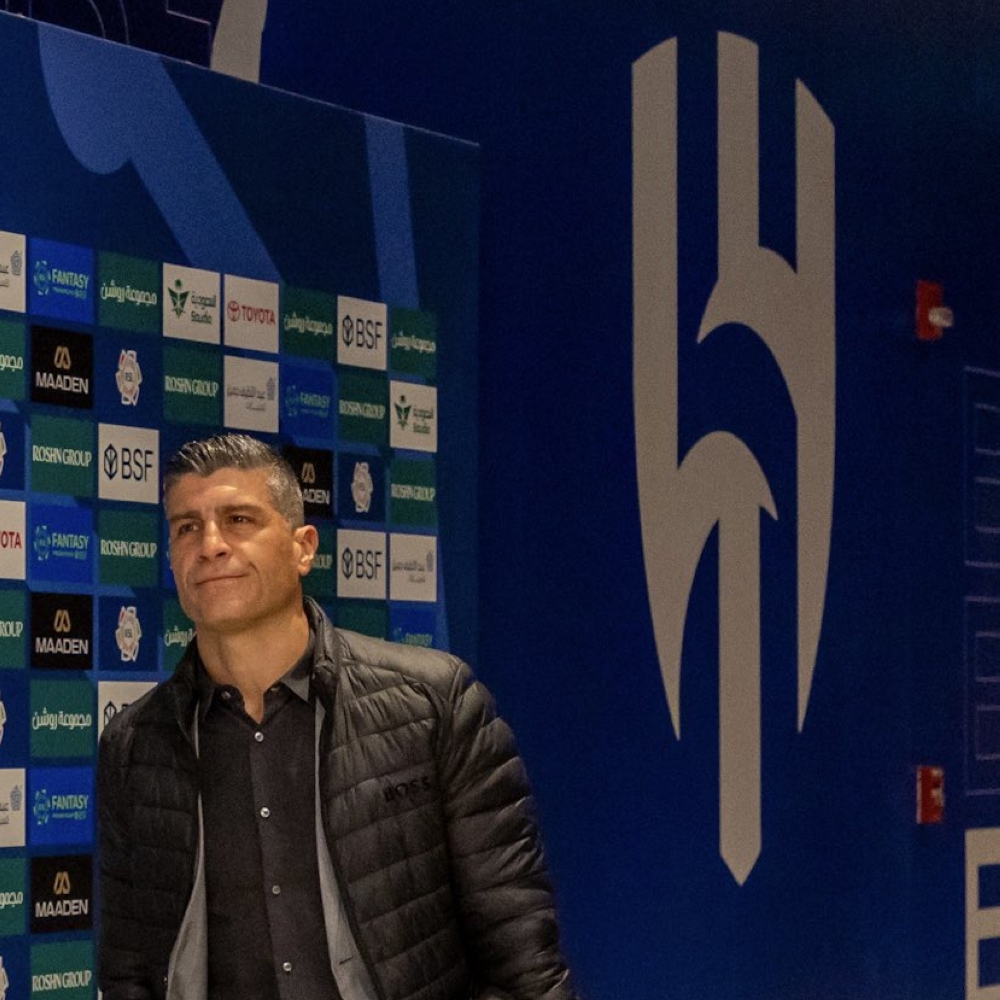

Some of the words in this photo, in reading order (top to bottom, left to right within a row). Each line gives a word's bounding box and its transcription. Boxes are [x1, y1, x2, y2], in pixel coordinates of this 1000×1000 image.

[52, 269, 89, 288] FANTASY
[241, 305, 275, 325] TOYOTA
[356, 318, 382, 350] BSF
[36, 371, 88, 393] MAADEN
[165, 375, 191, 393] ROSHN
[192, 379, 218, 397] GROUP
[122, 447, 153, 481] BSF
[302, 488, 331, 505] ADEN
[101, 539, 128, 556] ROSHN
[129, 541, 156, 558] GROUP
[356, 550, 382, 579] BSF
[52, 794, 88, 809] FANTASY
[36, 899, 87, 917] MAADEN
[32, 973, 61, 991] ROSHN
[62, 970, 91, 988] GROUP
